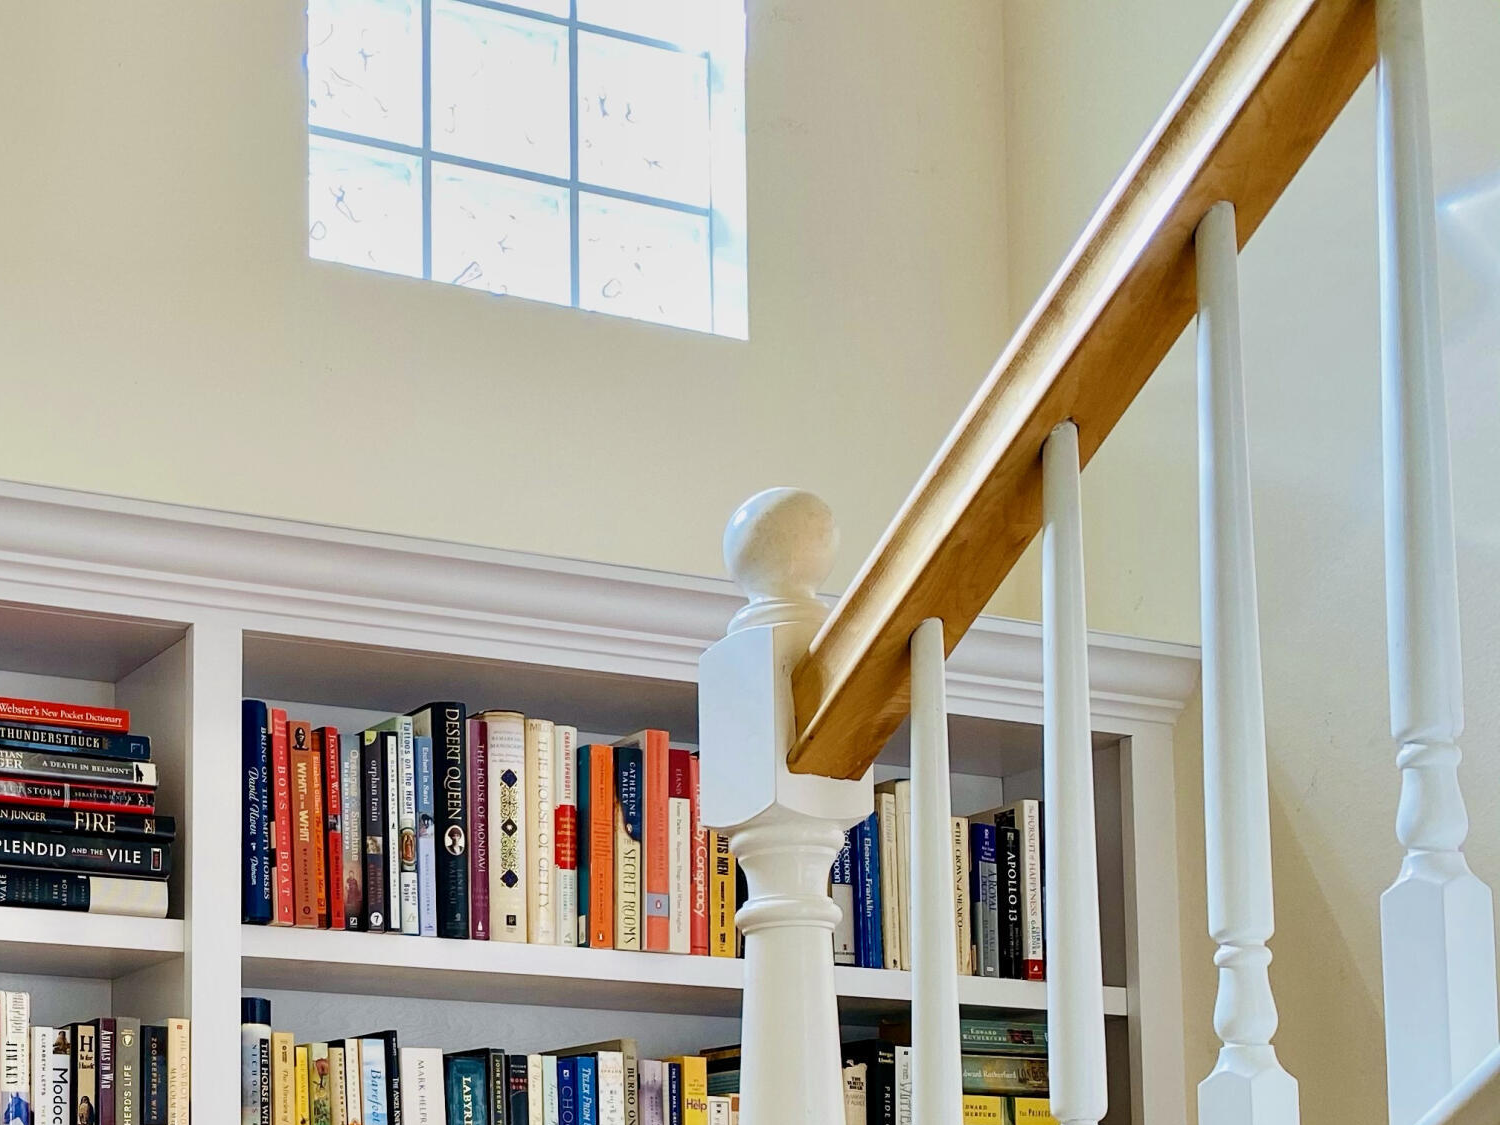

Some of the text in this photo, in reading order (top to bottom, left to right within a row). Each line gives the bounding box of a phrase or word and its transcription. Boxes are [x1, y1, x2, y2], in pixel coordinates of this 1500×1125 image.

[42, 708, 58, 718] New
[60, 710, 83, 721] Pocket
[86, 712, 122, 725] Dictionary
[0, 726, 100, 749] THUNDERSTRUCK
[444, 708, 461, 820] DESERT QUEEN
[10, 809, 47, 822] JUNGER
[74, 812, 116, 833] FIRE
[107, 847, 141, 864] VILE
[1007, 851, 1017, 921] APOLLO 13
[52, 1067, 68, 1125] Modoc
[686, 1099, 707, 1111] Help
